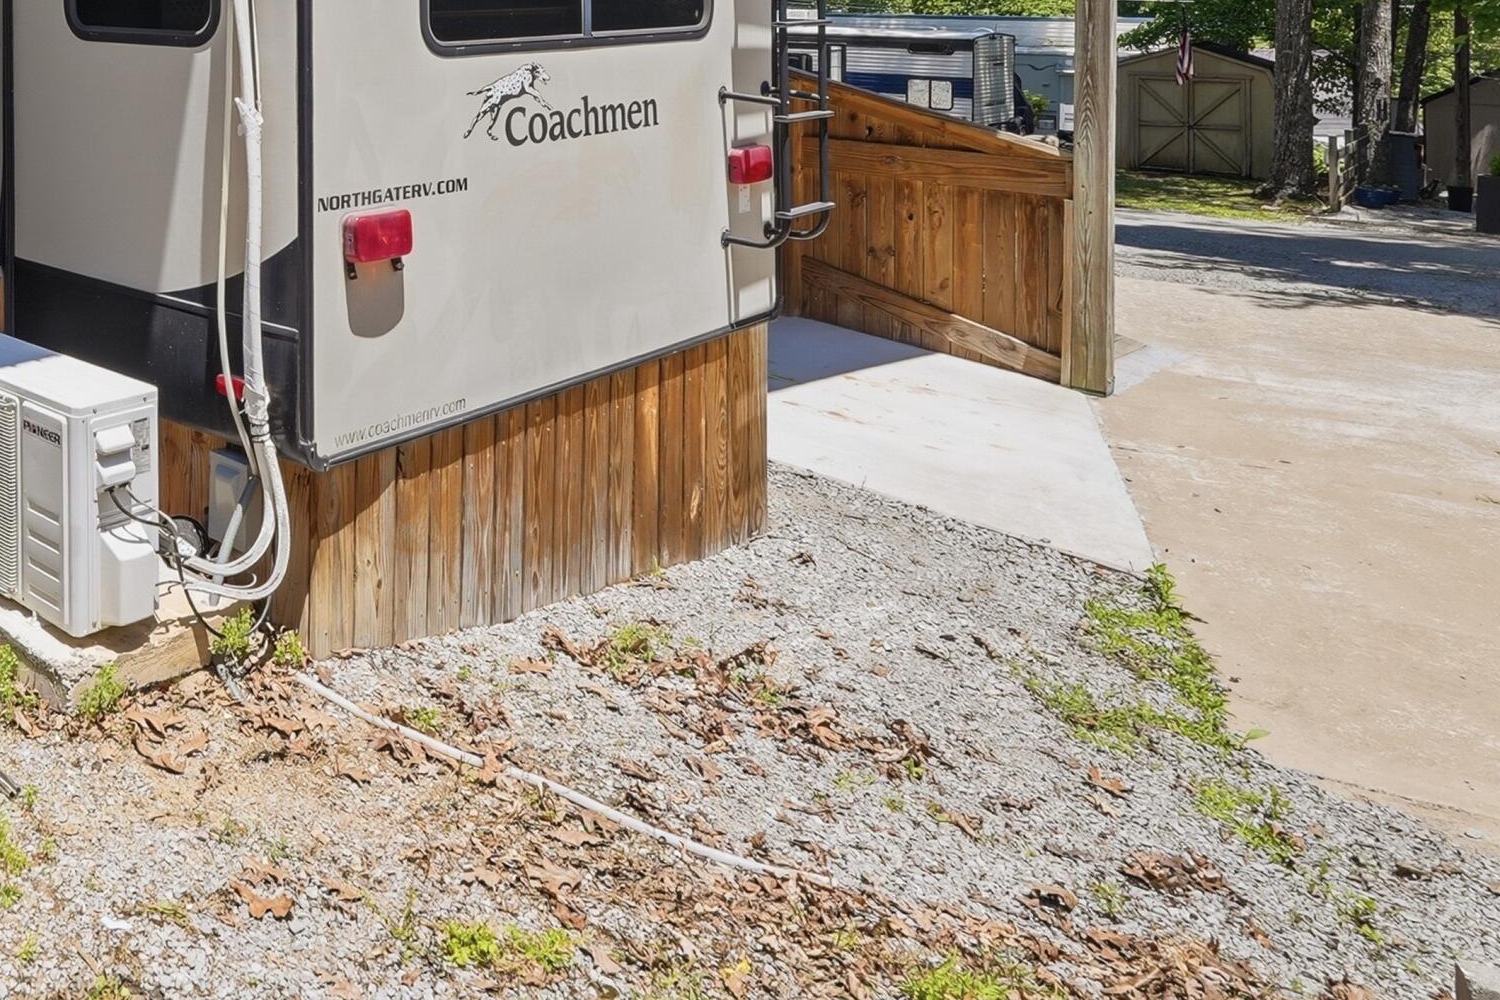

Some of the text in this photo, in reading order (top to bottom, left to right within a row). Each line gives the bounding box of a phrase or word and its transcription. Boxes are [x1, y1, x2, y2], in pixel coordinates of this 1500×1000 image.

[505, 96, 659, 147] Coachmen
[317, 177, 468, 213] NORTHGATERV.COM
[334, 397, 466, 448] www.coachmenrv.com
